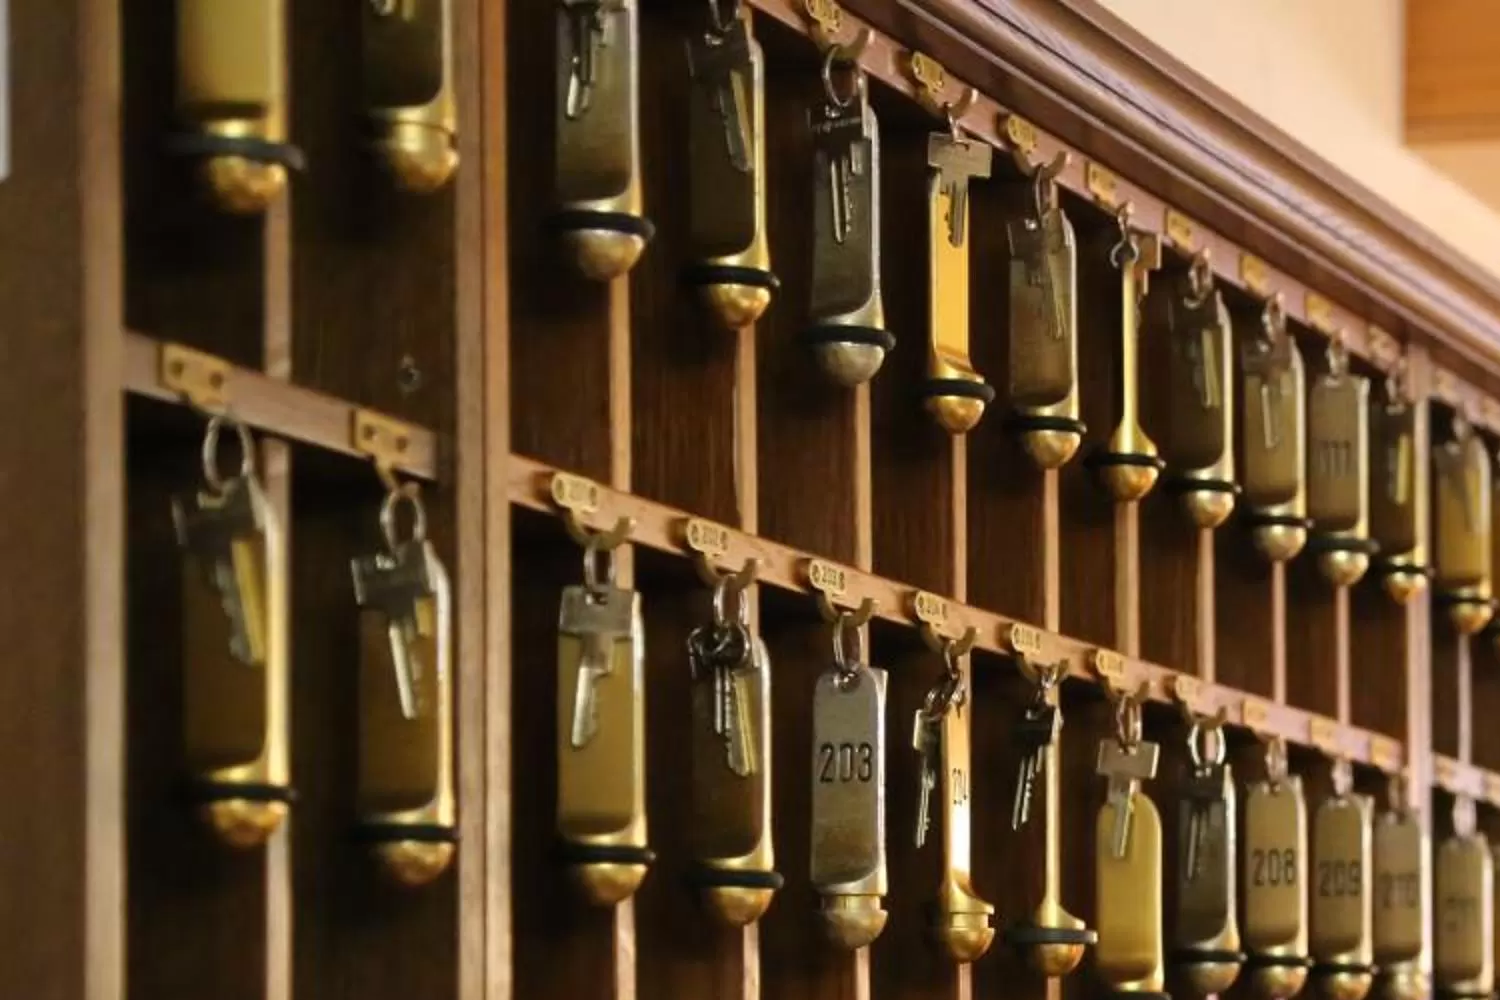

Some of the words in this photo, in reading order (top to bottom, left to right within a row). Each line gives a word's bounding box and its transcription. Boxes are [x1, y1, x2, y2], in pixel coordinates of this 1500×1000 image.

[819, 741, 873, 784] 203
[1253, 847, 1296, 887] 208
[1318, 859, 1361, 897] 209
